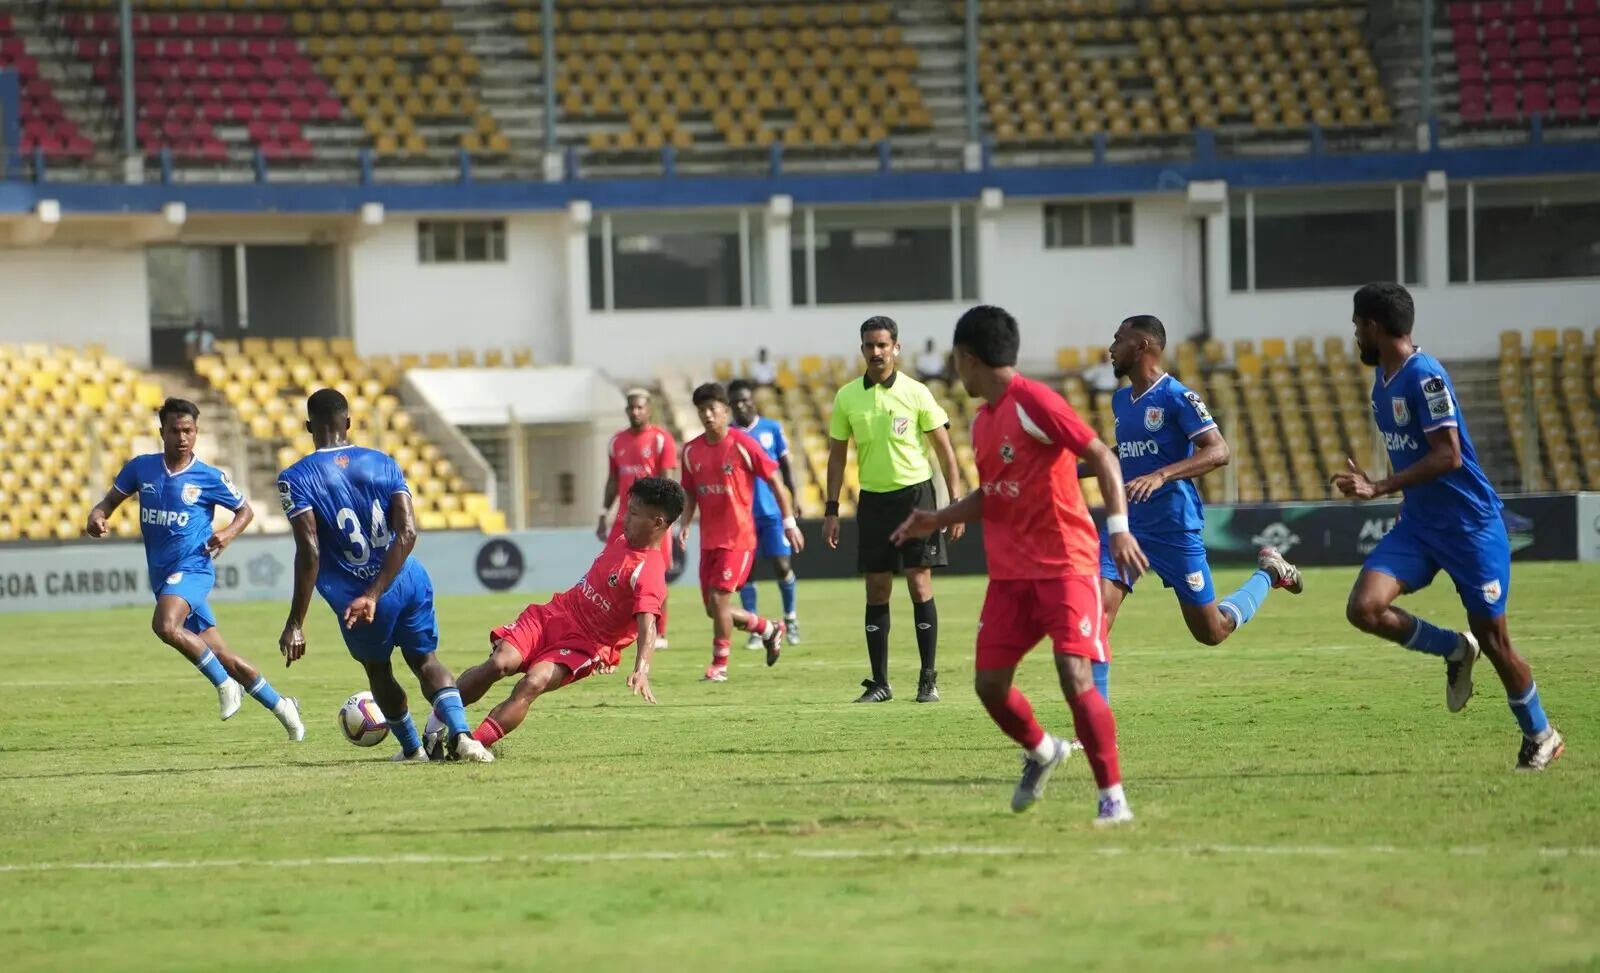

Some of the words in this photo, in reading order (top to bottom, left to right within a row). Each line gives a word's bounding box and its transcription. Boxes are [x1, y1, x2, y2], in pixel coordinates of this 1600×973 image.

[142, 507, 189, 527] DEMPO
[336, 499, 394, 566] 34
[45, 568, 138, 596] CARBON
